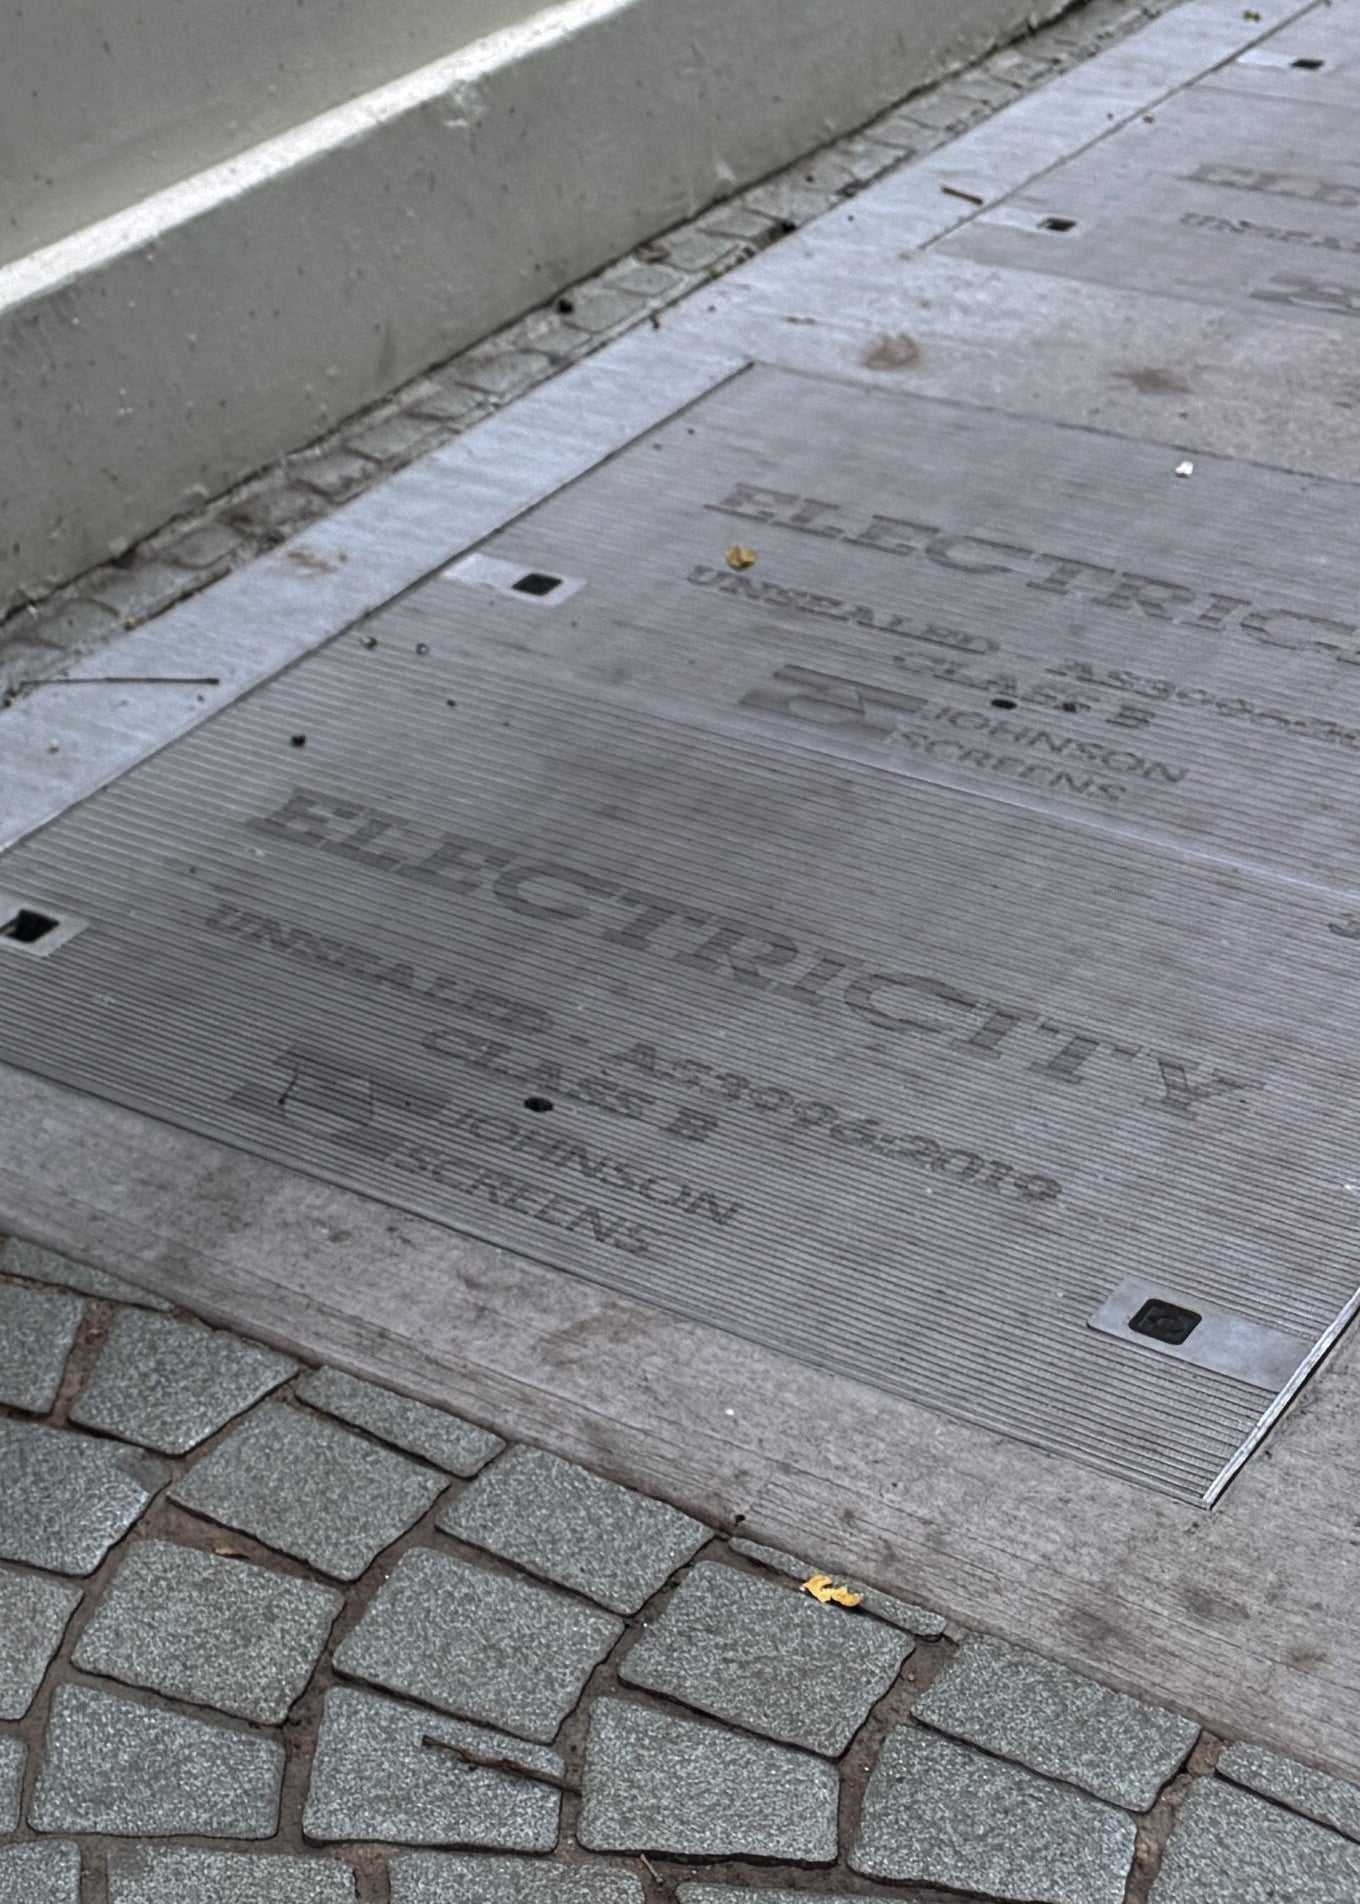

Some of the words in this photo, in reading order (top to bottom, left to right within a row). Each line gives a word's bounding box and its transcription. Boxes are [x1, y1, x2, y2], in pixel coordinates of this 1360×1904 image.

[702, 482, 1360, 667] ELECTRIC
[891, 730, 1129, 801] SCREENS
[932, 705, 1191, 785] JOHNSON
[245, 787, 1268, 1120] ELECTRICITY
[393, 1145, 653, 1258] SCREENS
[438, 1110, 740, 1226] JOHNSON
